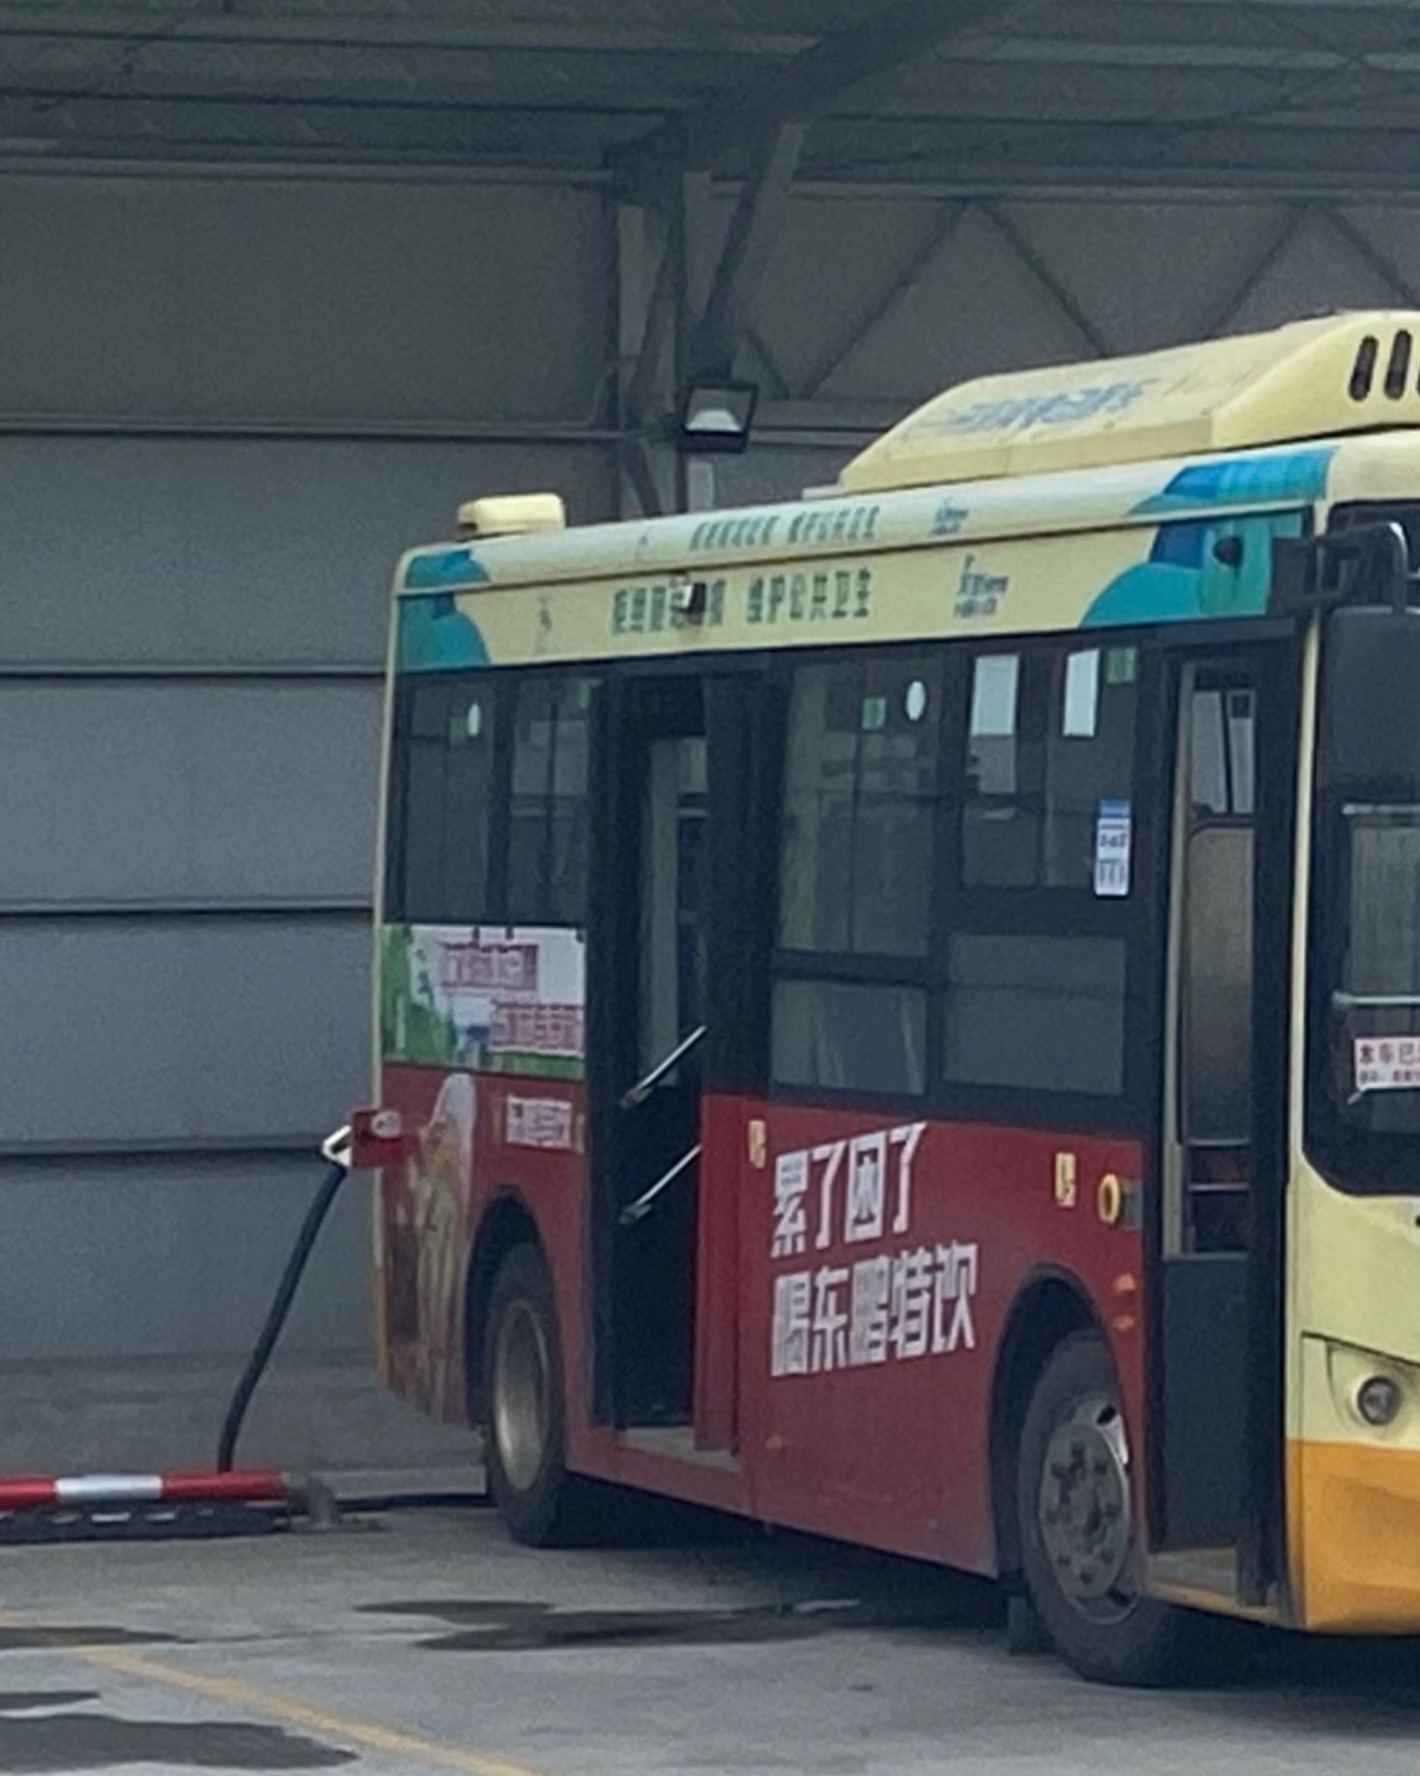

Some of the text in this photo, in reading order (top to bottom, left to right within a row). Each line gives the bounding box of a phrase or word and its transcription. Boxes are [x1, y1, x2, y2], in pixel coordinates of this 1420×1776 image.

[770, 1122, 927, 1258] 累了困了
[771, 1239, 978, 1377] 喝东鹏特饮
